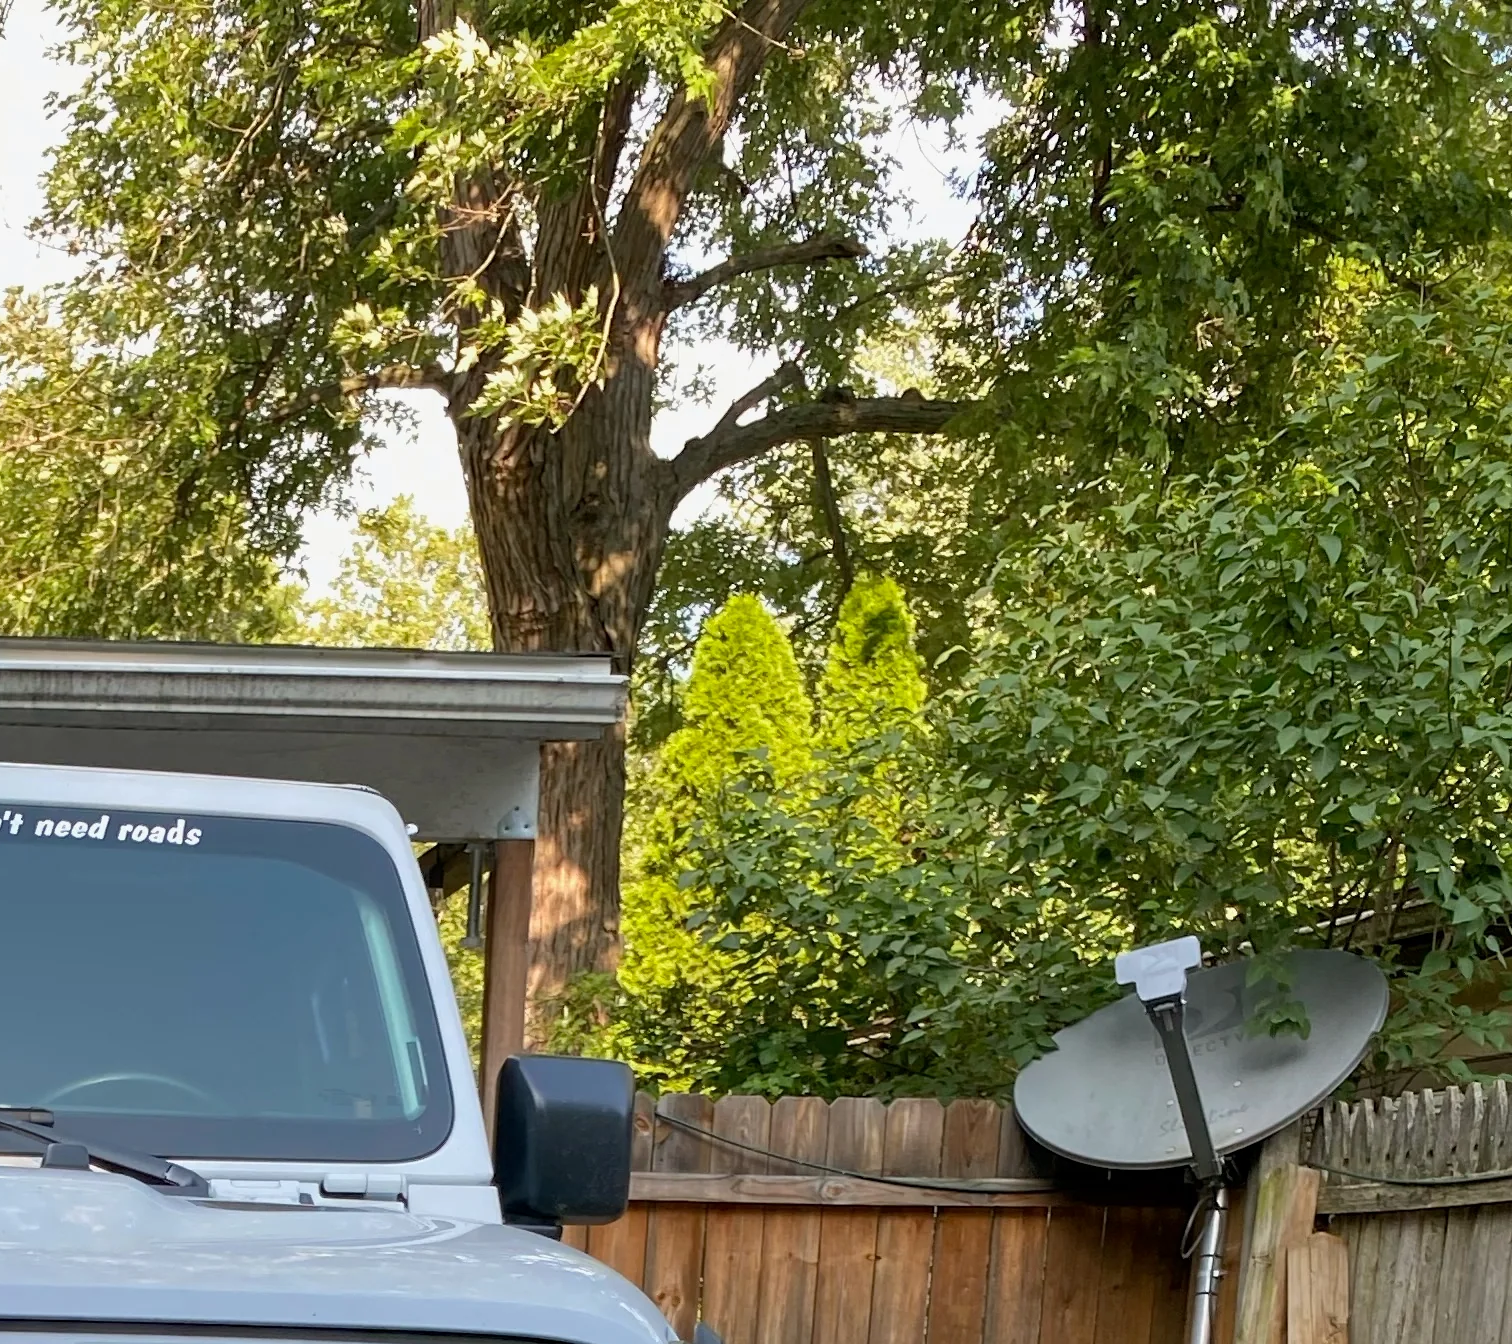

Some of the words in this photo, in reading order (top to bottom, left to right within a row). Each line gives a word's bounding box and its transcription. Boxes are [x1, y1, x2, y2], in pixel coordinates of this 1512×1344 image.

[34, 814, 110, 840] need
[117, 818, 202, 846] roads
[1154, 1031, 1245, 1066] DECTV
